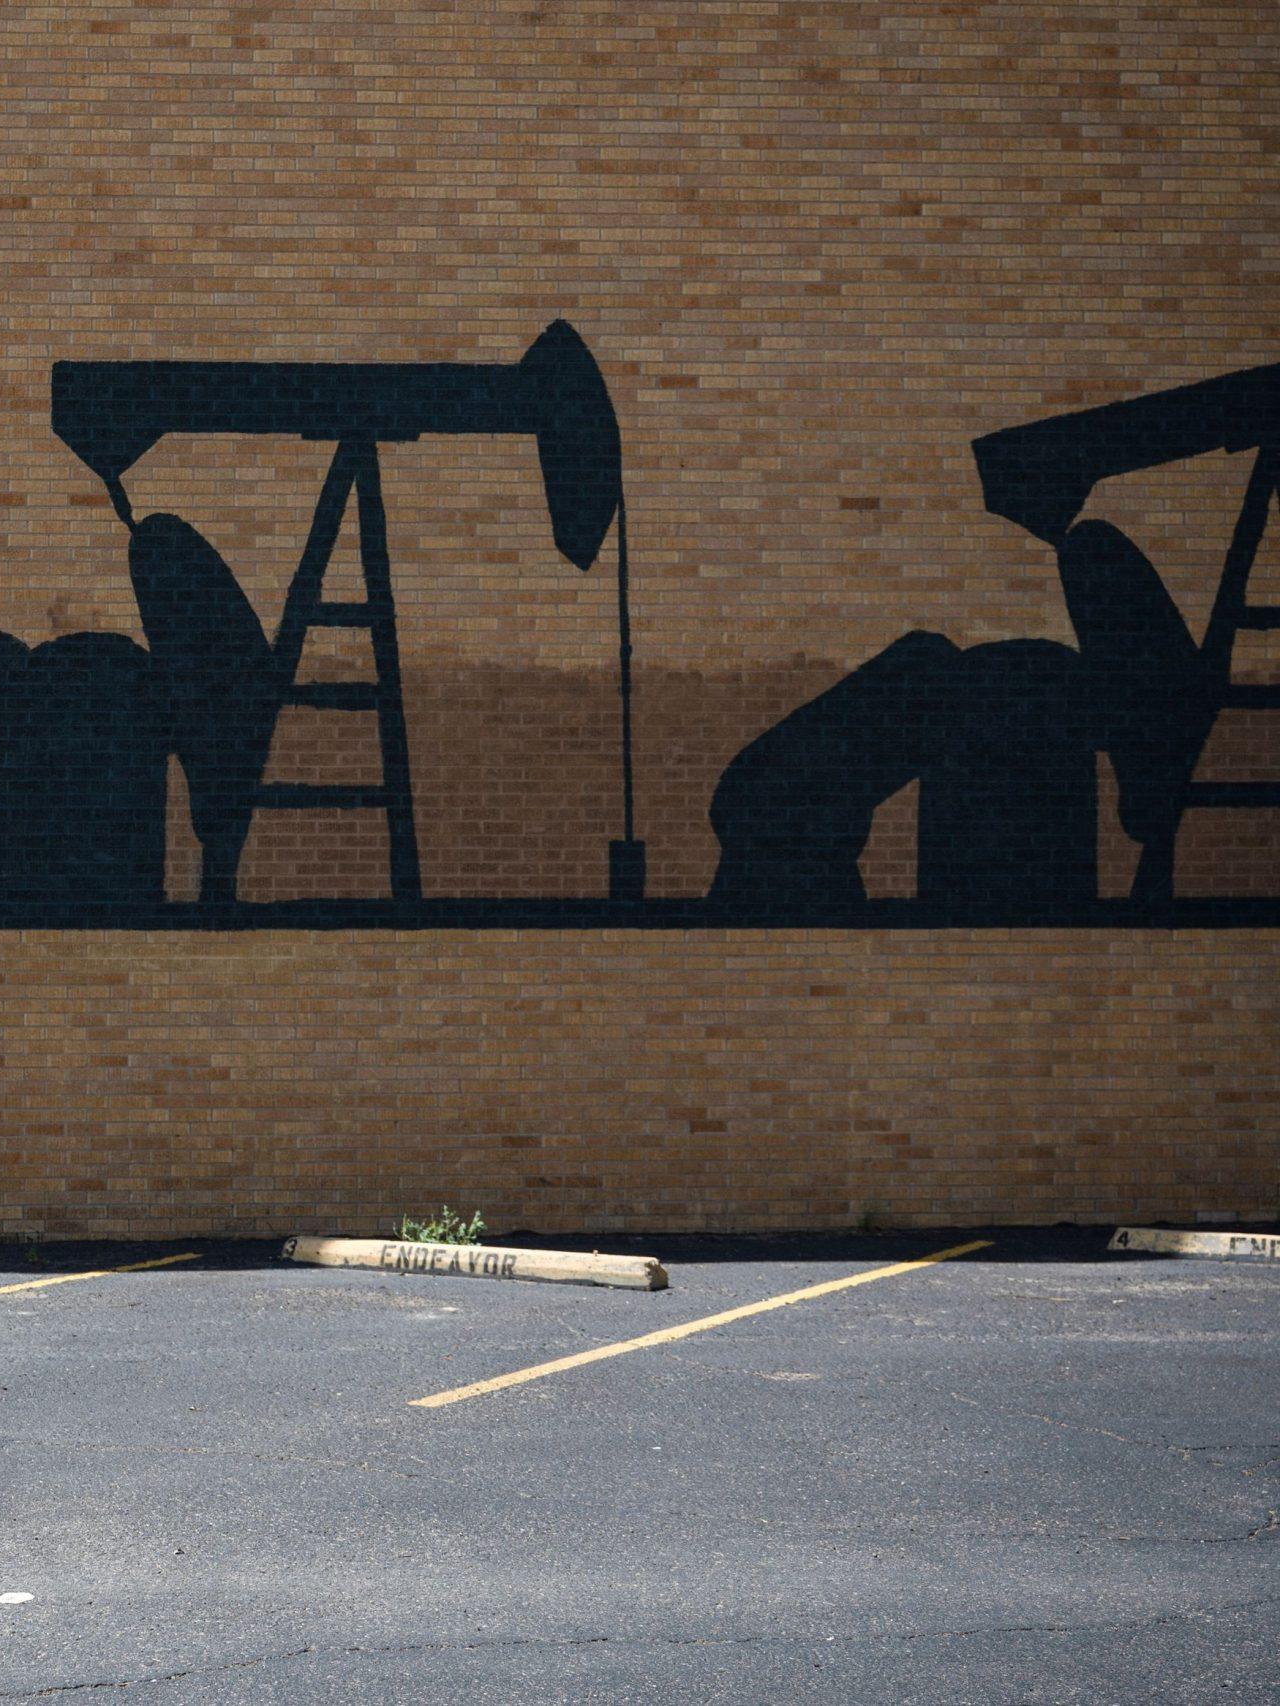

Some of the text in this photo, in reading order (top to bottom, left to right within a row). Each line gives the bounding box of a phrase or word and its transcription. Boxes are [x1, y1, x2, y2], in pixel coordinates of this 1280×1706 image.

[286, 1238, 298, 1256] 3
[1117, 1230, 1129, 1247] 4
[380, 1244, 517, 1278] ENDEAVOR
